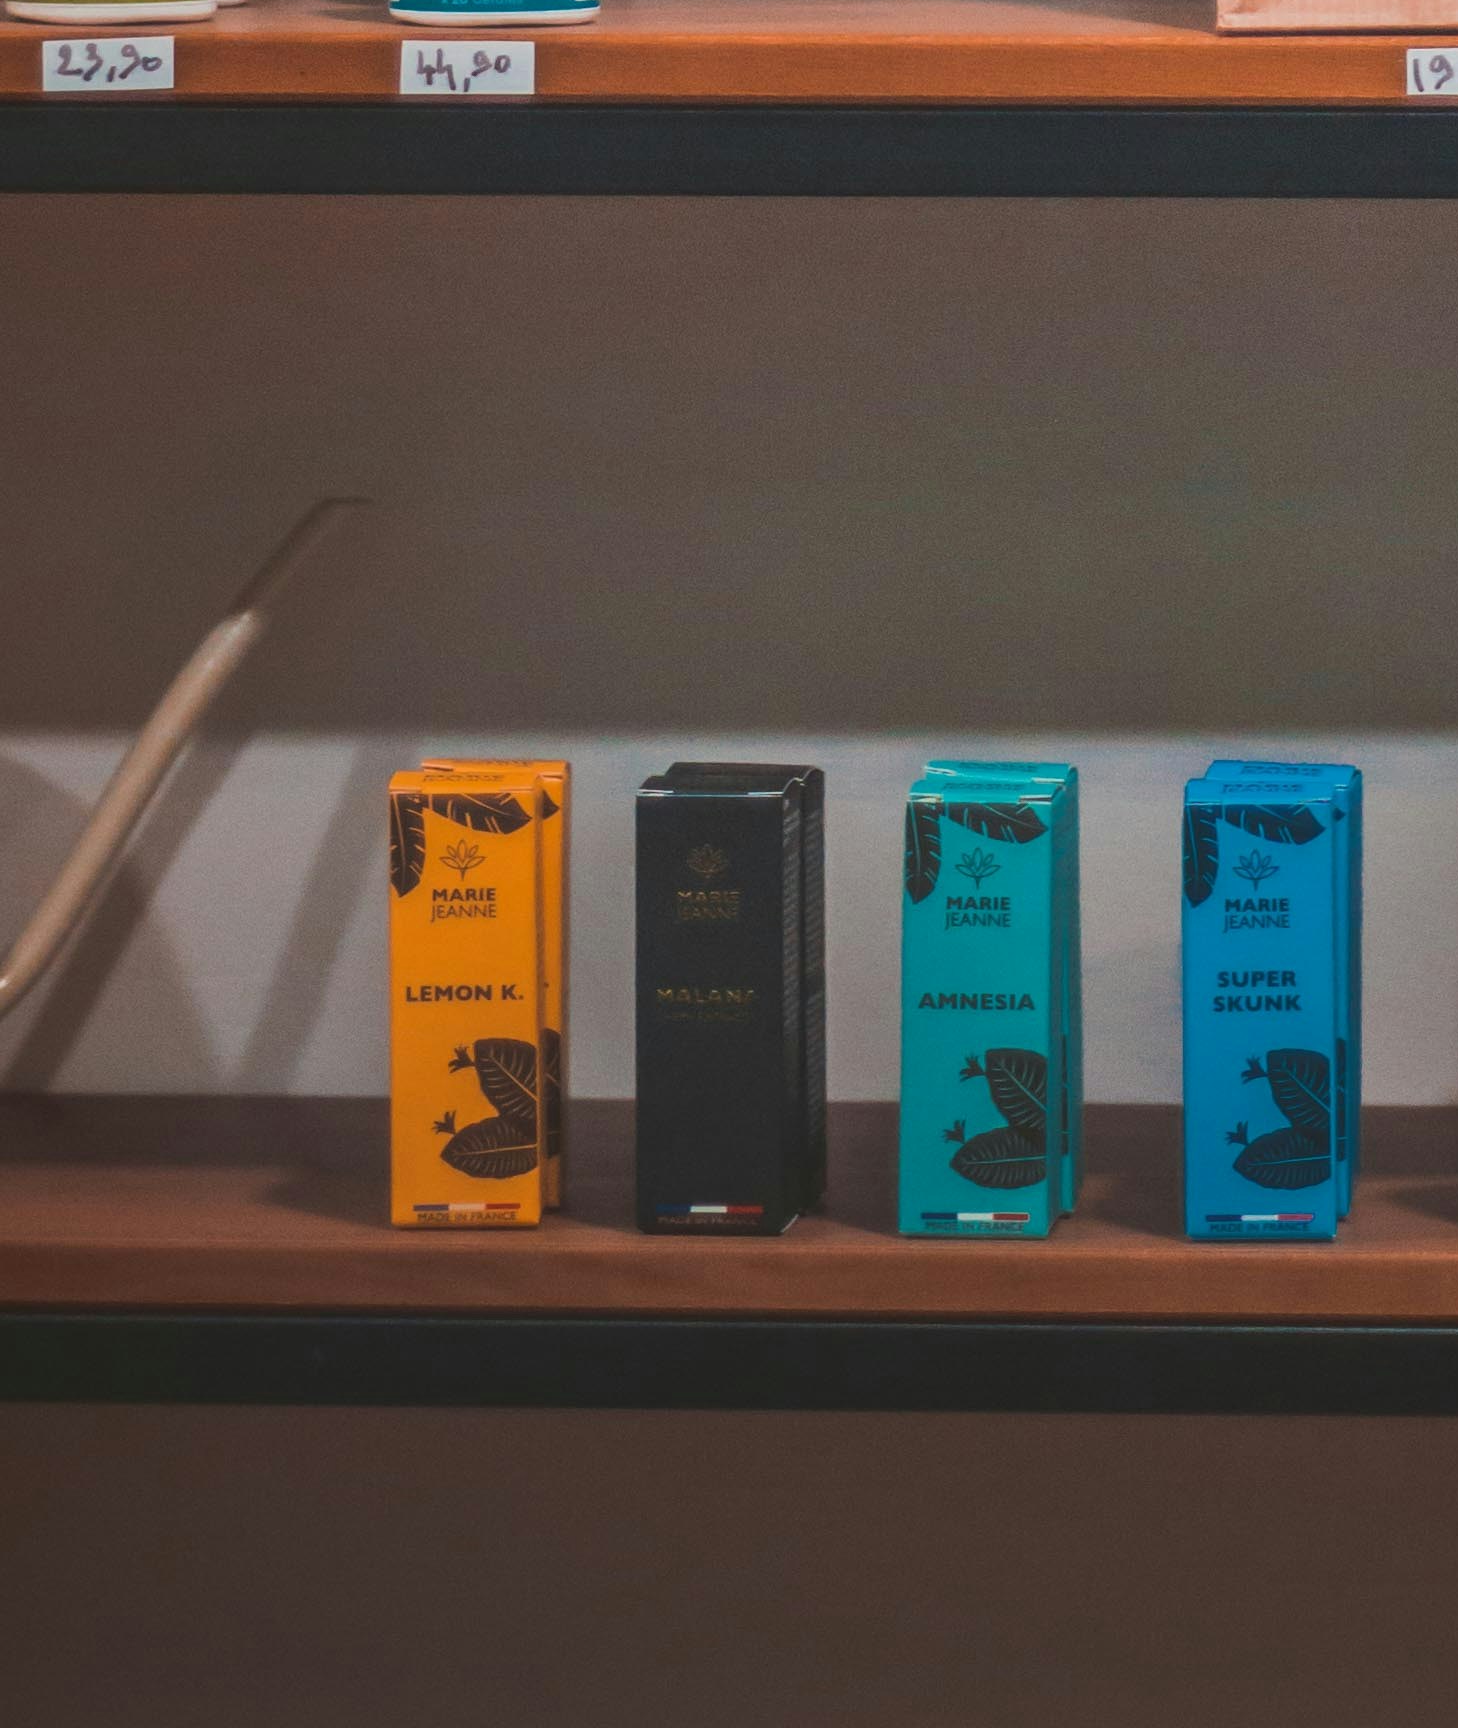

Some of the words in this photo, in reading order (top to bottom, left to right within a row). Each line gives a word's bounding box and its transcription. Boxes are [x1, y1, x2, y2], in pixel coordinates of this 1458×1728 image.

[432, 888, 496, 901] MARIE
[946, 896, 1010, 910] MARIE
[430, 903, 496, 922] JEANNE
[1225, 898, 1289, 912] MARIE
[945, 913, 1010, 930] JEANNE
[1224, 914, 1290, 932] JEANNE
[1218, 971, 1296, 988] SUPER
[406, 985, 493, 1002] LEMON
[919, 993, 1035, 1010] AMNESIA
[1213, 995, 1301, 1012] SKUNK
